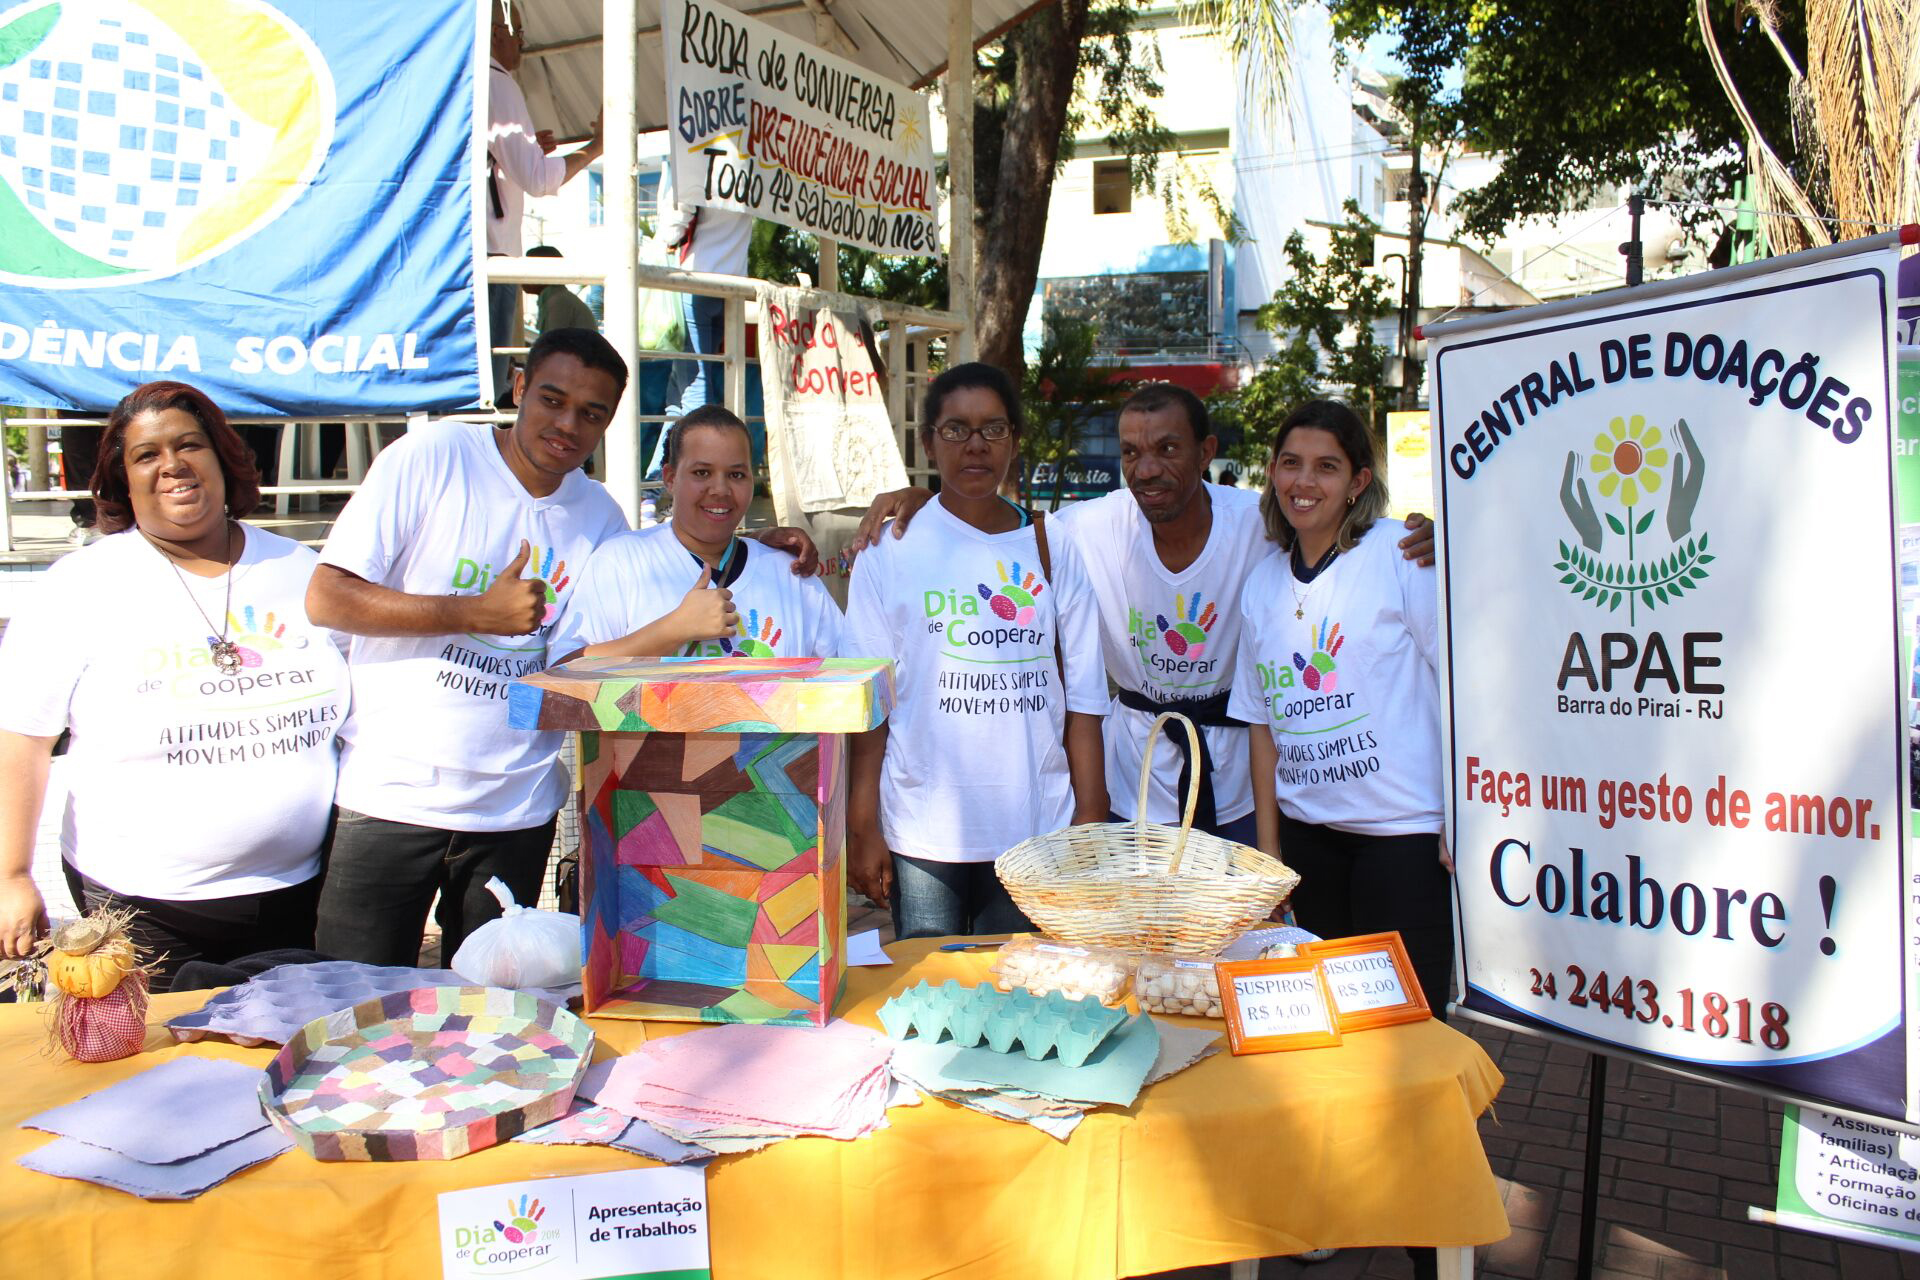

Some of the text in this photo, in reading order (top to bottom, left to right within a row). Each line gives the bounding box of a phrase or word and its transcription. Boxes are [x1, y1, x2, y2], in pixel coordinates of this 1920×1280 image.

[680, 0, 896, 141] RODA de CONVERSA
[679, 83, 932, 211] SOBRE PREVIDÊNCIA SOCIAL
[703, 147, 764, 208] Todo
[867, 203, 887, 248] do
[769, 304, 839, 351] Roda
[230, 332, 430, 376] SOCIAL
[1450, 332, 1872, 480] CENTRAL DE DOAÇÕES
[924, 588, 979, 618] Dia
[928, 619, 1045, 648] de Cooperar
[1557, 632, 1725, 694] APAE
[137, 680, 162, 693] de
[436, 670, 496, 700] MOVEM
[939, 697, 995, 714] MOVEM
[1000, 697, 1009, 713] O
[1271, 692, 1355, 720] Cooperar
[1557, 695, 1605, 715] Barra
[1610, 696, 1632, 716] do
[1637, 697, 1681, 718] Piraí
[1698, 700, 1723, 719] RJ
[167, 727, 331, 766] MOVEM O MUNDO
[1310, 768, 1319, 784] O
[1322, 756, 1380, 784] MUNDO
[1466, 756, 1881, 840] Faça um gesto de amor.
[1489, 838, 1787, 948] Colabore
[1818, 874, 1837, 956] !
[1234, 978, 1313, 996] SUSPIROS
[1338, 979, 1394, 997] R$ 2,00
[1247, 1005, 1269, 1020] R$
[1530, 963, 1791, 1050] 24 2443.1818
[1820, 1132, 1893, 1159] famílias)
[1830, 1155, 1920, 1181] Articulaçã
[1829, 1174, 1916, 1201] Formação
[588, 1198, 702, 1222] Apresentação
[1828, 1193, 1899, 1217] Oficinas
[455, 1225, 496, 1248] Dia
[589, 1221, 697, 1243] de Trabalhos
[456, 1244, 552, 1265] de Cooperar
